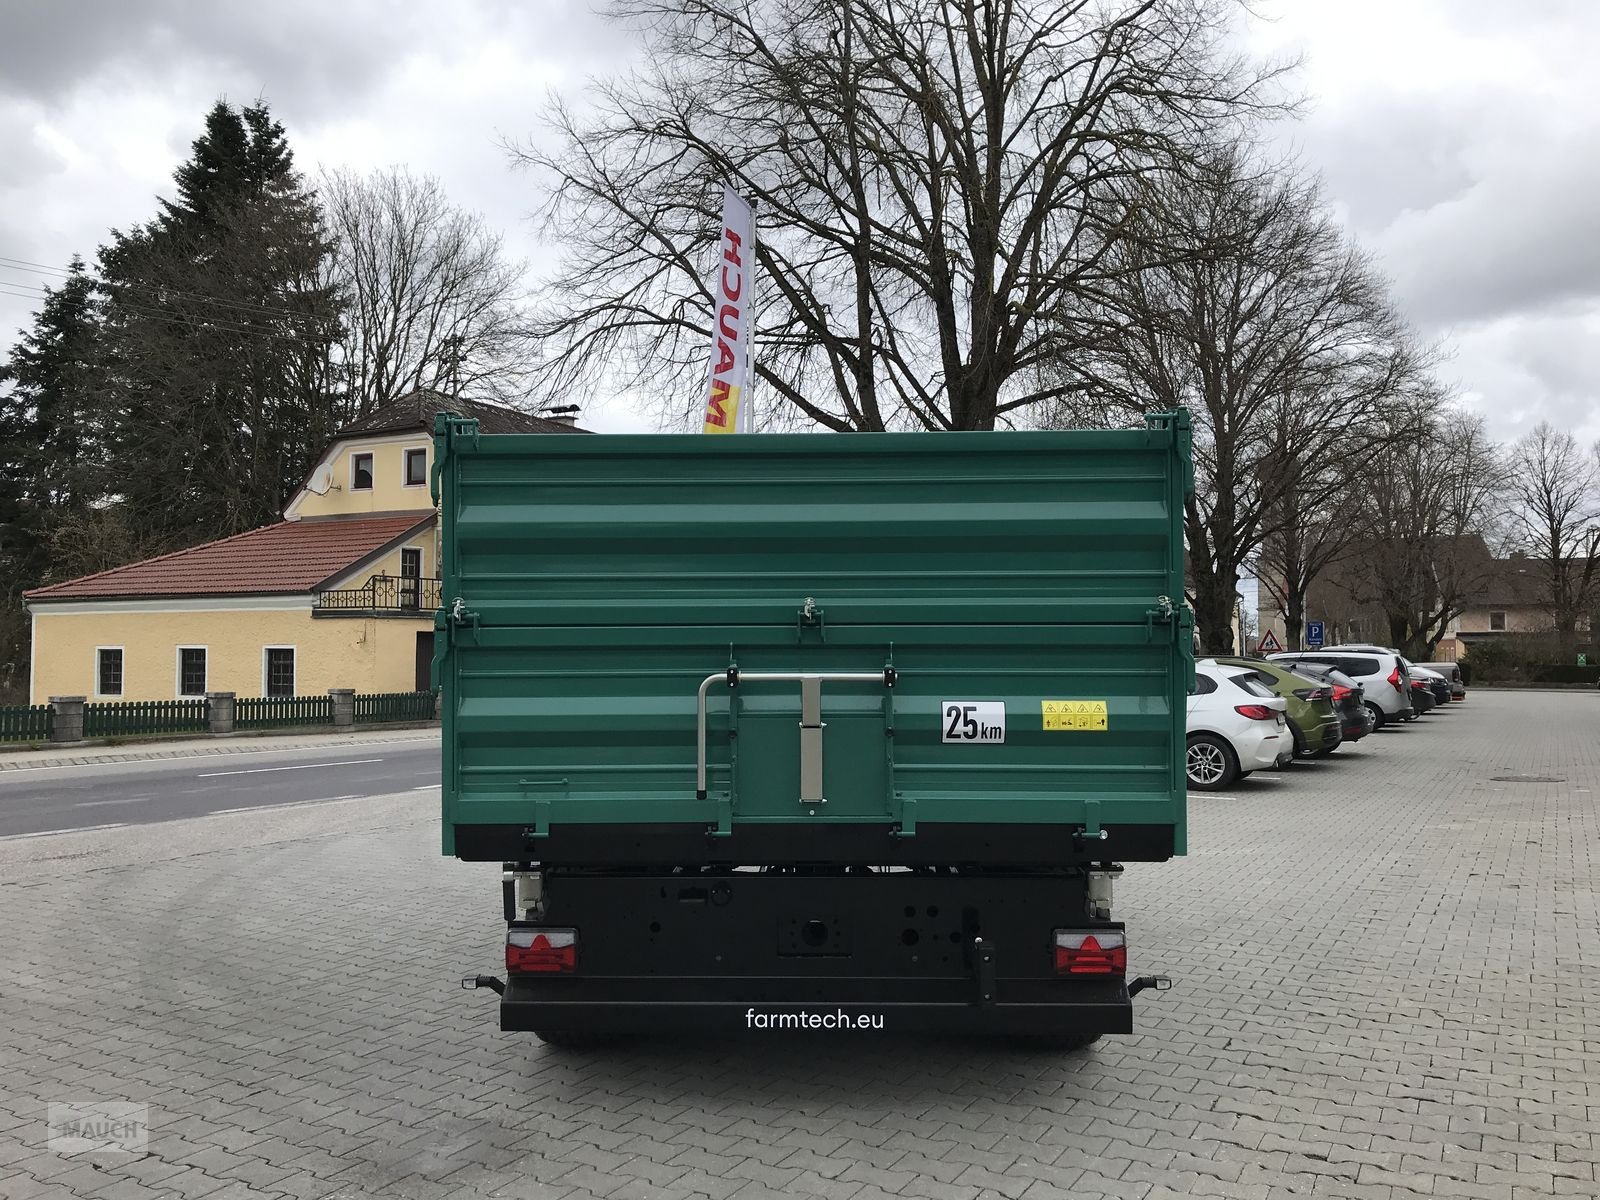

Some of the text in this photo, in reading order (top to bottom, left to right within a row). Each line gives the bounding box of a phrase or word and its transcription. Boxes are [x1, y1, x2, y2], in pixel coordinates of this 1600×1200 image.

[1312, 626, 1320, 638] P
[946, 706, 1002, 740] 25 km
[745, 1008, 884, 1029] farmtech.eu
